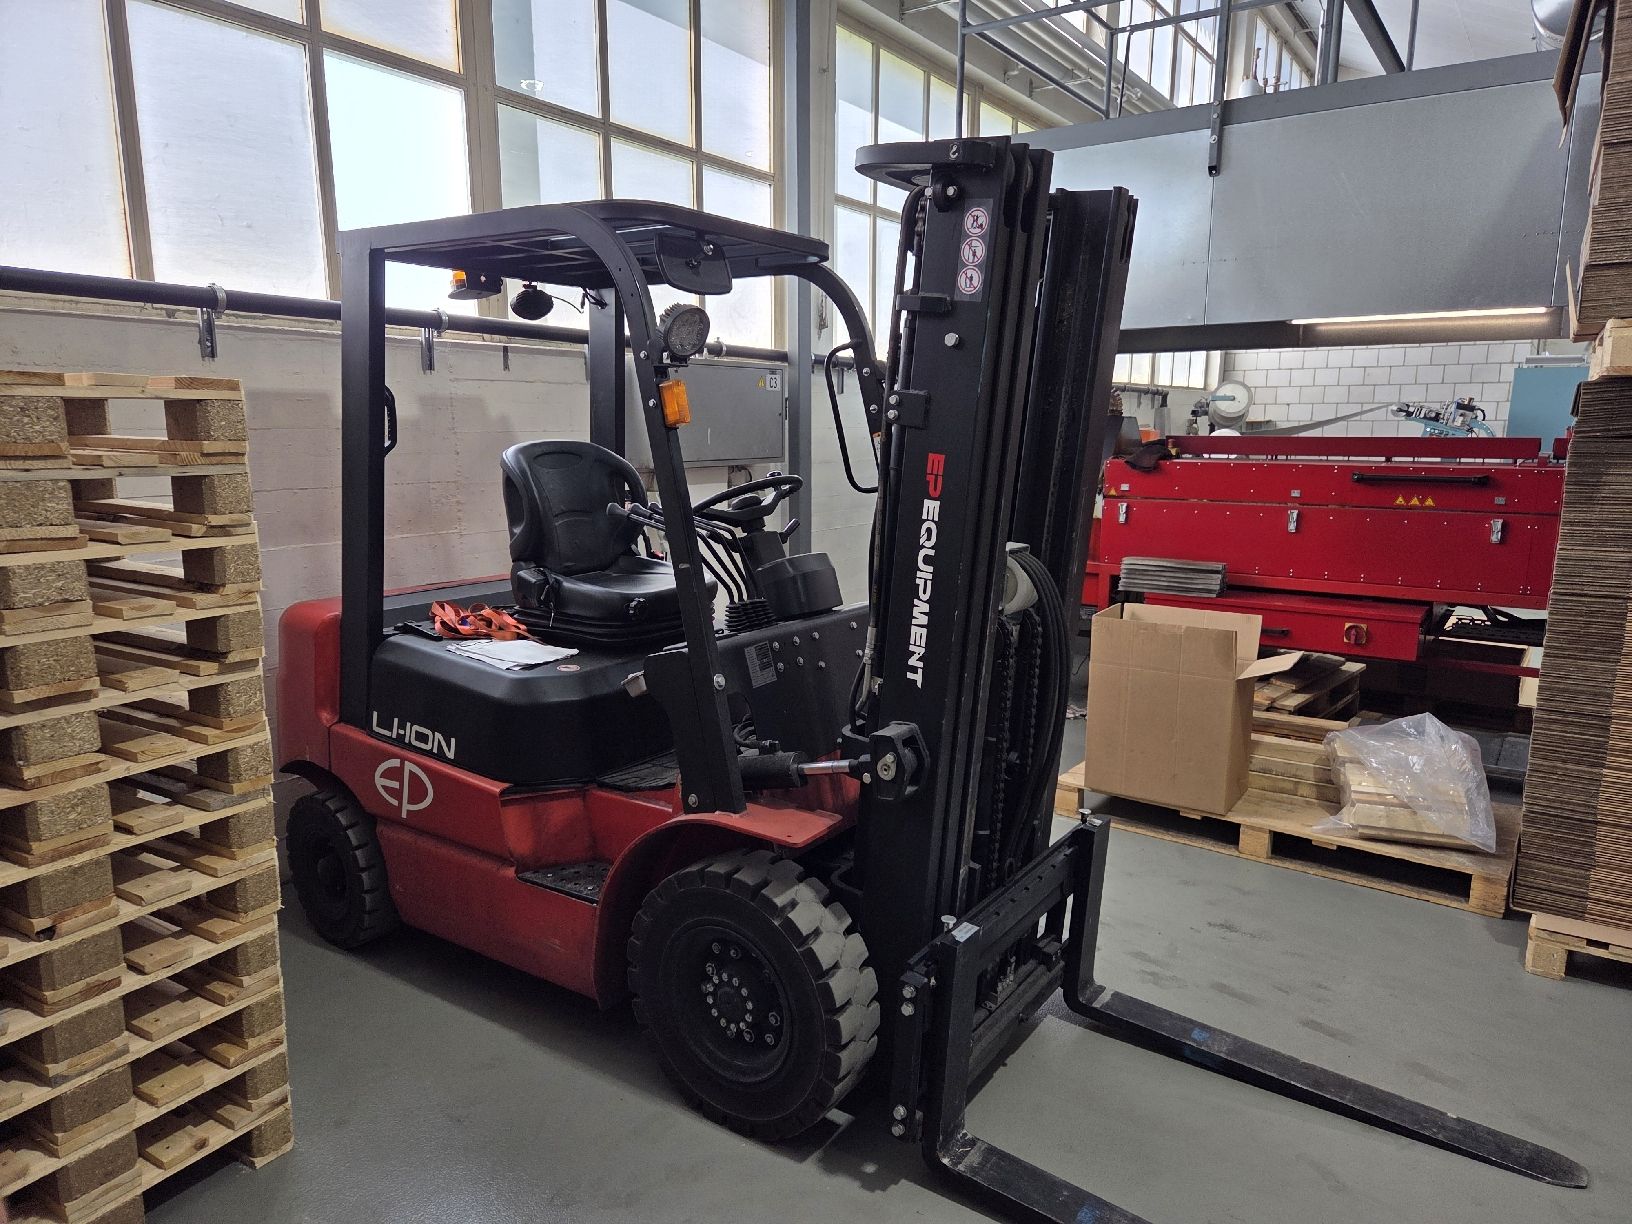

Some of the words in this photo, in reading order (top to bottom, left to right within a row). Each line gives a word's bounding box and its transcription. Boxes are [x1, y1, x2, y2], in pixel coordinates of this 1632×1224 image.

[925, 452, 946, 498] EP
[906, 499, 941, 689] EQUIPMENT
[374, 758, 434, 819] EP
